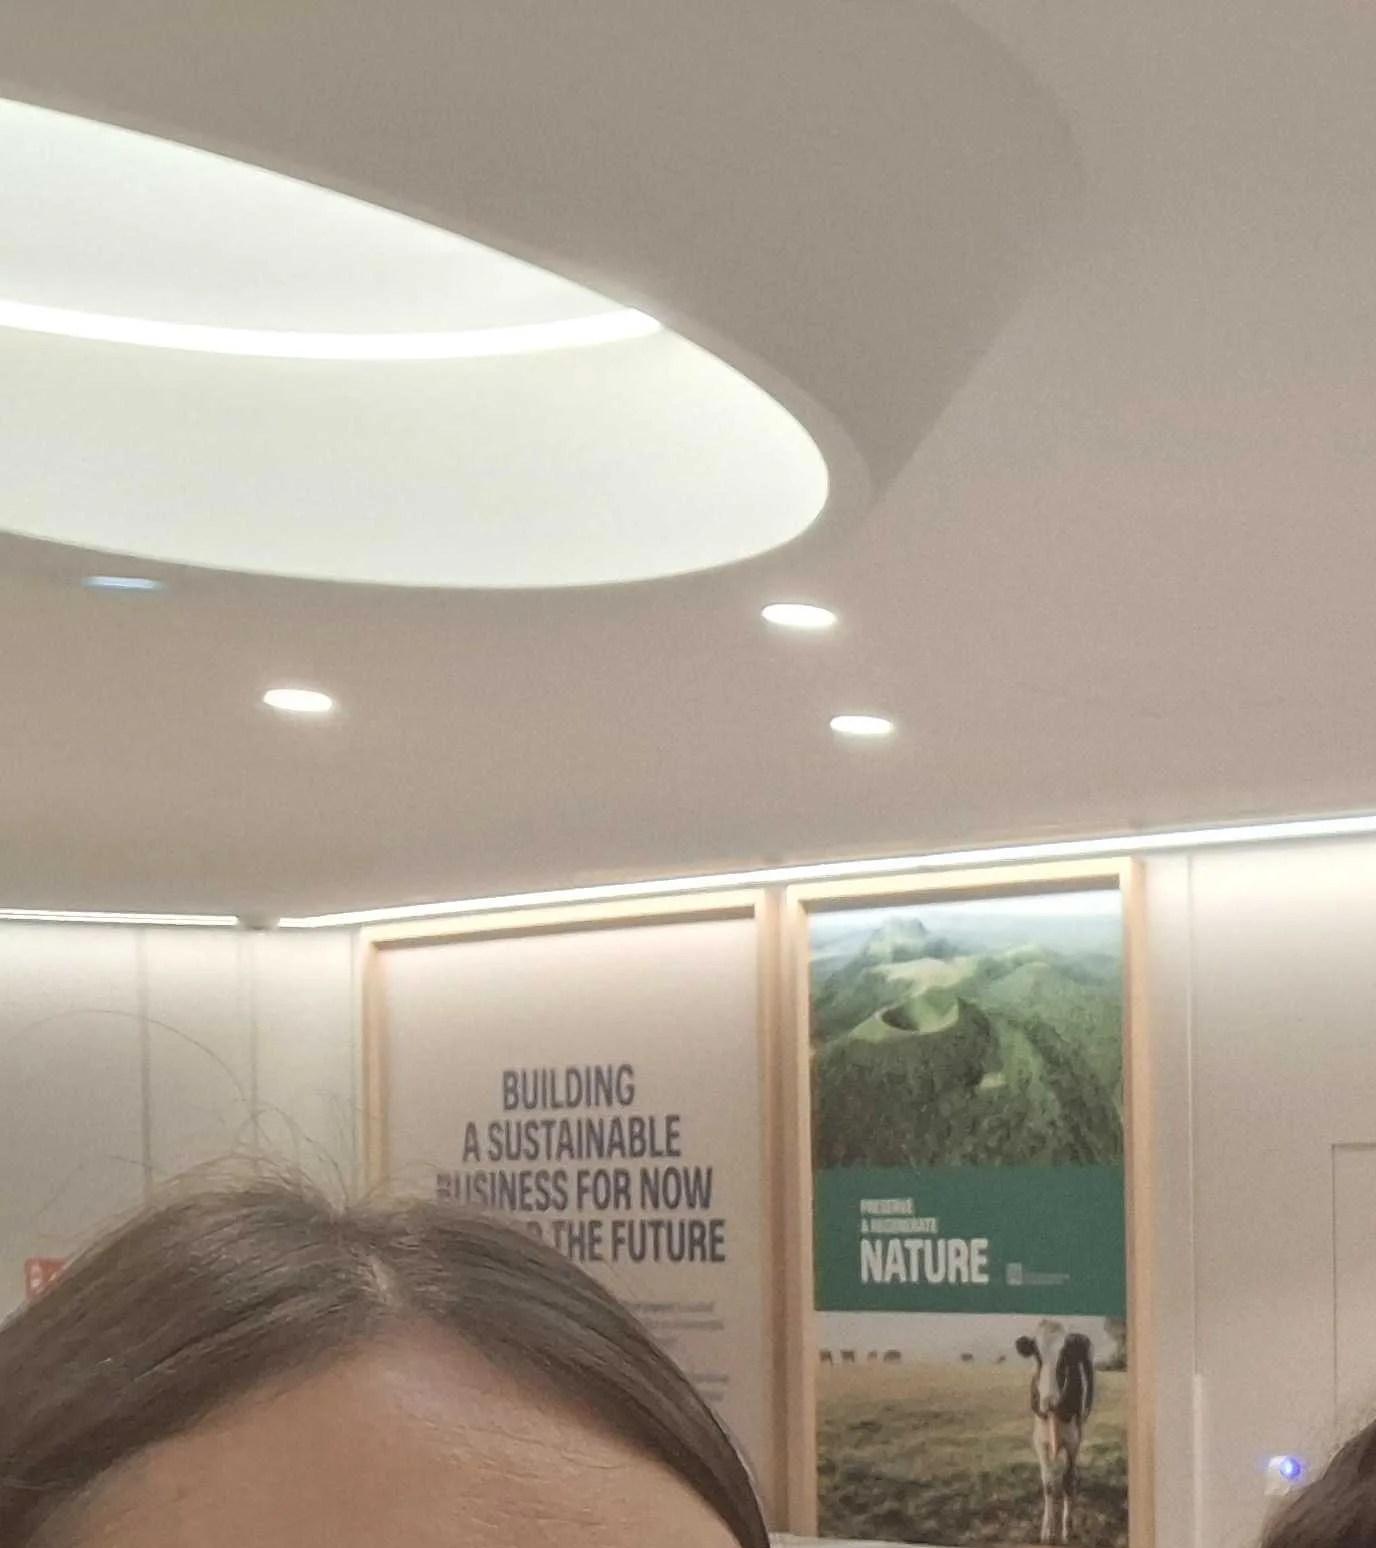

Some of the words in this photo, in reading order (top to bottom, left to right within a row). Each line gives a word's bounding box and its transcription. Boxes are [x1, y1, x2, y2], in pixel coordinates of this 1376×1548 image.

[502, 1064, 634, 1111] BUILDING
[463, 1121, 481, 1163] A
[488, 1115, 682, 1162] SUSTAINABLE
[576, 1168, 633, 1212] FOR
[640, 1165, 714, 1211] NOW
[551, 1219, 604, 1263] THE
[611, 1218, 728, 1263] FUTURE
[860, 1237, 990, 1285] NATURE
